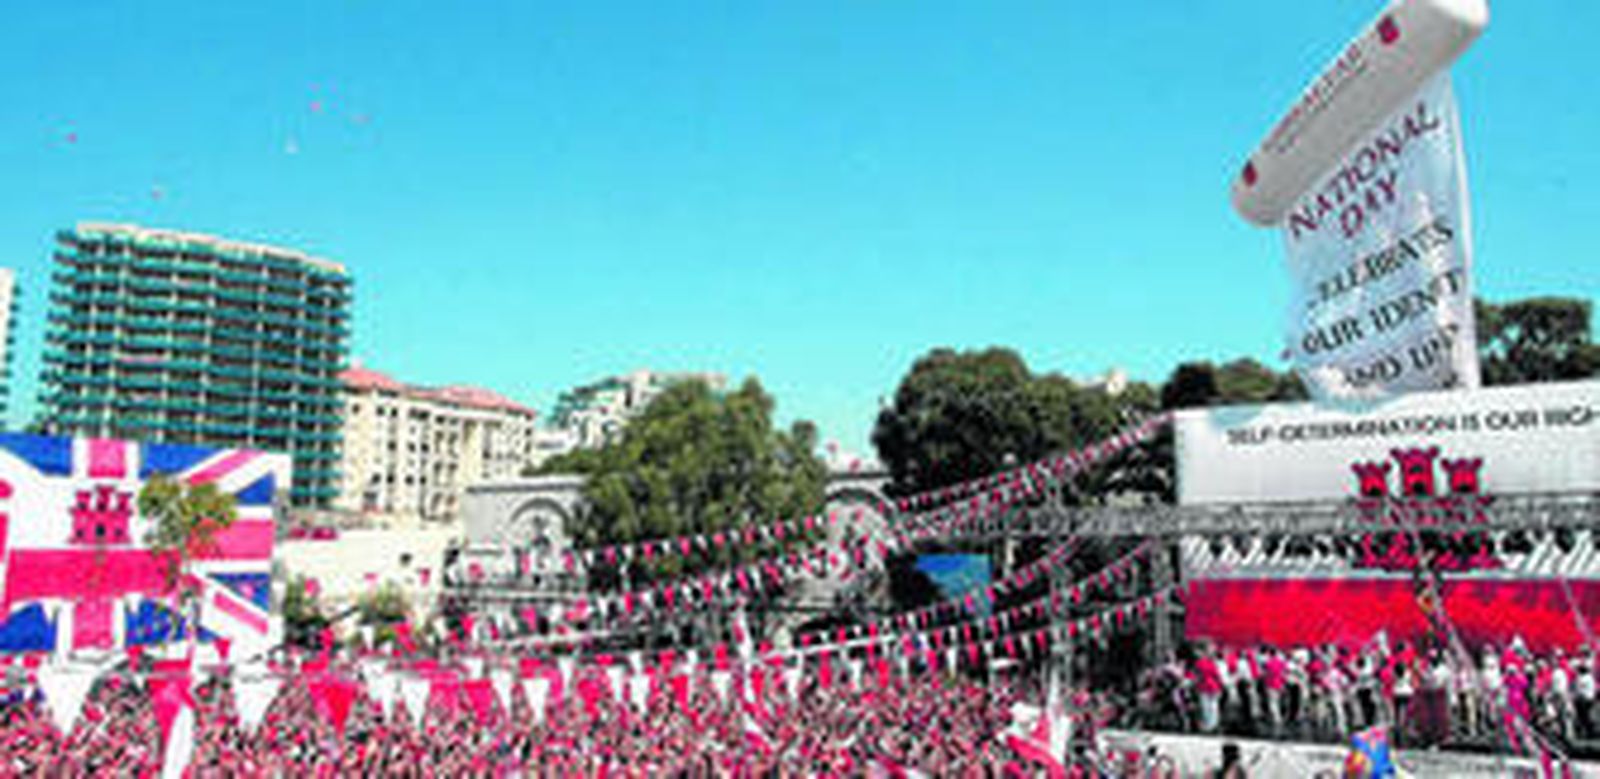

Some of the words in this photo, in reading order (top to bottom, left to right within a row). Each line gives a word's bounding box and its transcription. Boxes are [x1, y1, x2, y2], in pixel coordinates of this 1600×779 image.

[1289, 102, 1440, 240] NATIONAL
[1340, 170, 1397, 239] DAY
[1462, 413, 1480, 431] IS
[1485, 410, 1539, 431] OUR
